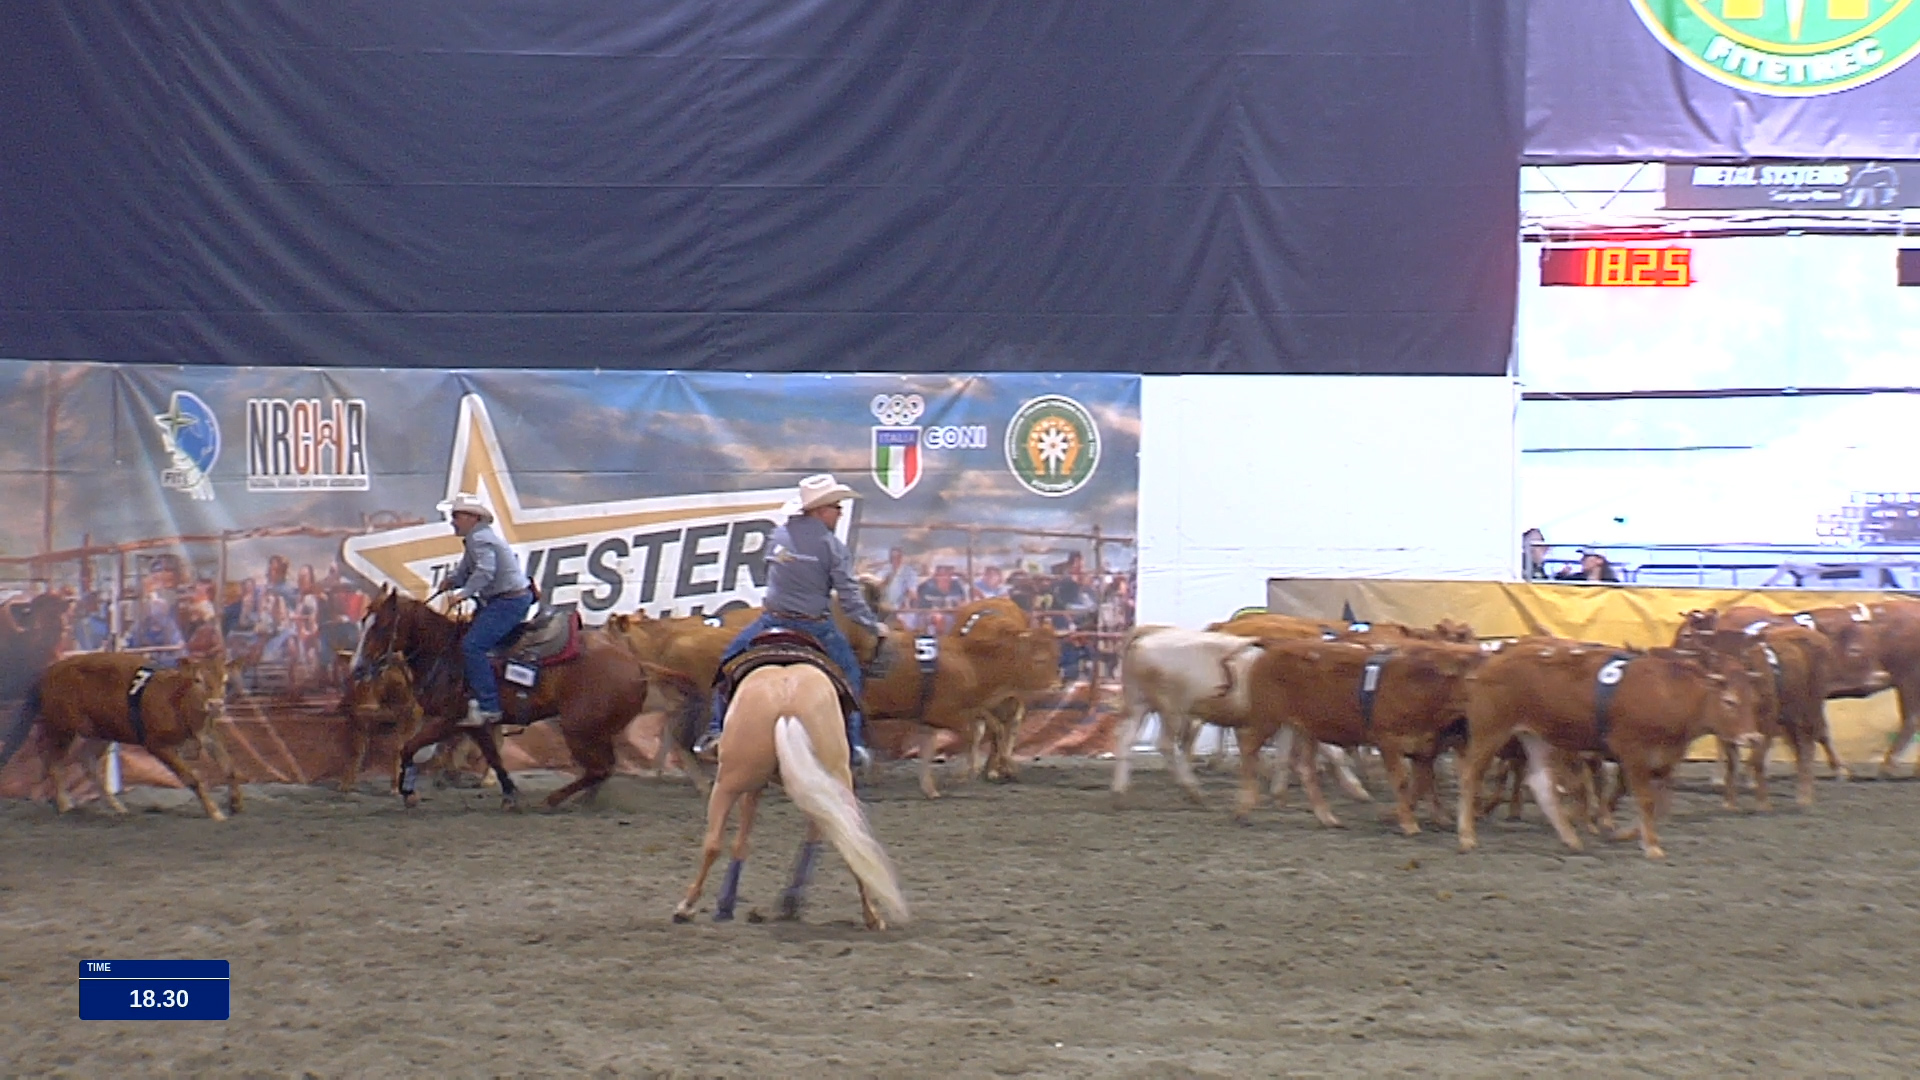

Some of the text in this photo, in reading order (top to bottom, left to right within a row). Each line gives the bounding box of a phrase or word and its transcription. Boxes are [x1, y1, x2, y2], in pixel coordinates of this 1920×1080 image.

[1703, 34, 1884, 84] FITETREC
[924, 425, 987, 449] CONI
[914, 637, 939, 662] 5
[1597, 660, 1629, 685] 6
